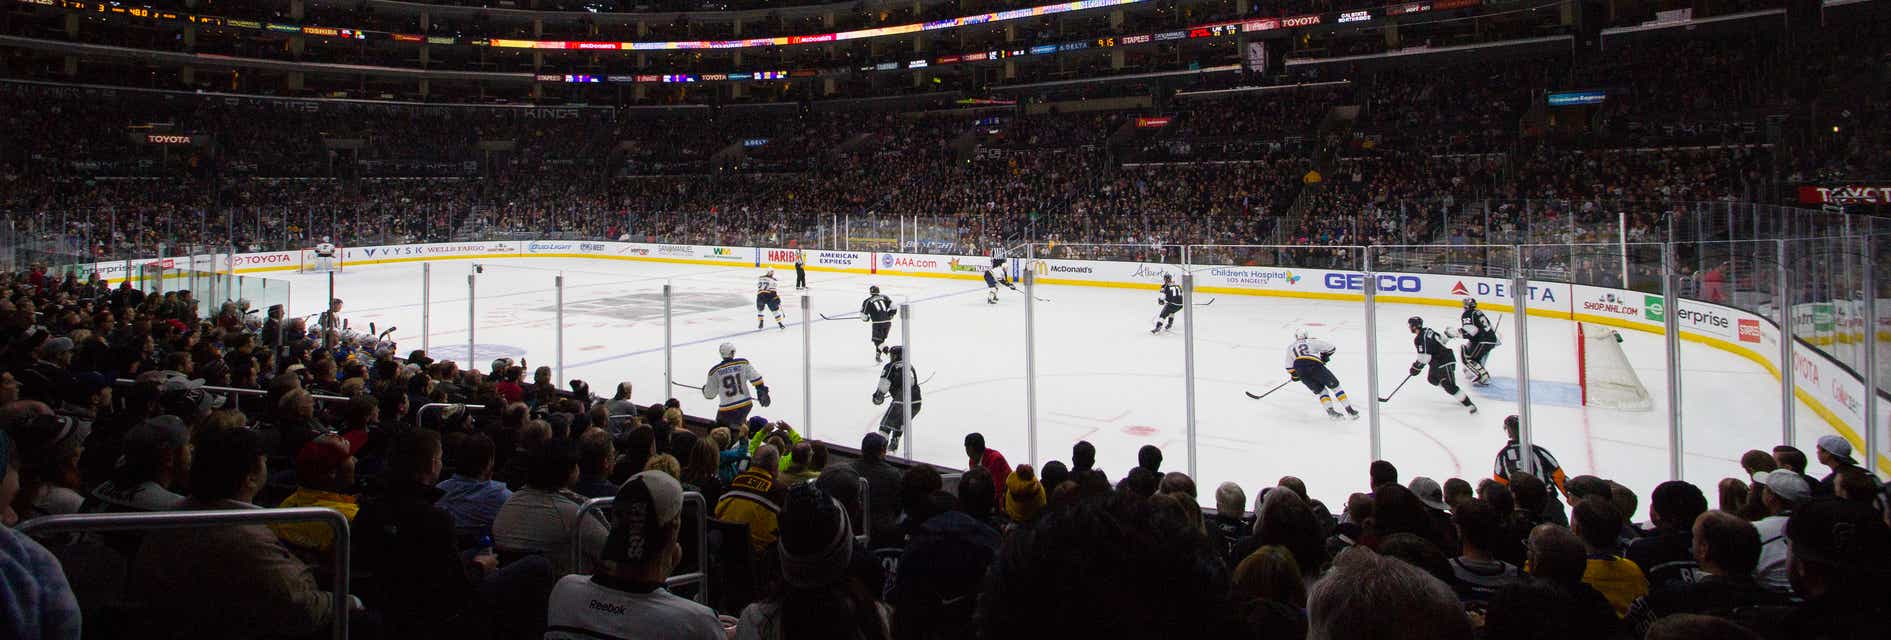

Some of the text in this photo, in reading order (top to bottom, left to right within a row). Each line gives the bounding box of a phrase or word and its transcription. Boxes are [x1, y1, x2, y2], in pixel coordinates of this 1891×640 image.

[1281, 15, 1321, 28] TOYOTA
[303, 26, 338, 36] TOSHIBA
[1121, 35, 1150, 45] STAPLES
[1065, 42, 1087, 51] DELTA
[148, 134, 192, 144] TOYOTA
[1816, 187, 1891, 204] TOYOT
[457, 245, 485, 253] FARGO
[245, 254, 291, 265] TOYOTA
[768, 250, 797, 263] HARIB
[819, 252, 859, 262] AMERICAN
[819, 258, 852, 267] EXPRESS
[894, 257, 937, 268] AAA.com
[1050, 265, 1093, 274] McDonald's
[1211, 269, 1286, 281] Children's Hospital
[1240, 277, 1268, 285] ANGELES
[1324, 272, 1422, 294] GECO
[1583, 301, 1638, 316] SHOP.NHL.COM
[1292, 343, 1310, 358] 12
[722, 373, 745, 398] 91
[588, 599, 627, 616] Reebok
